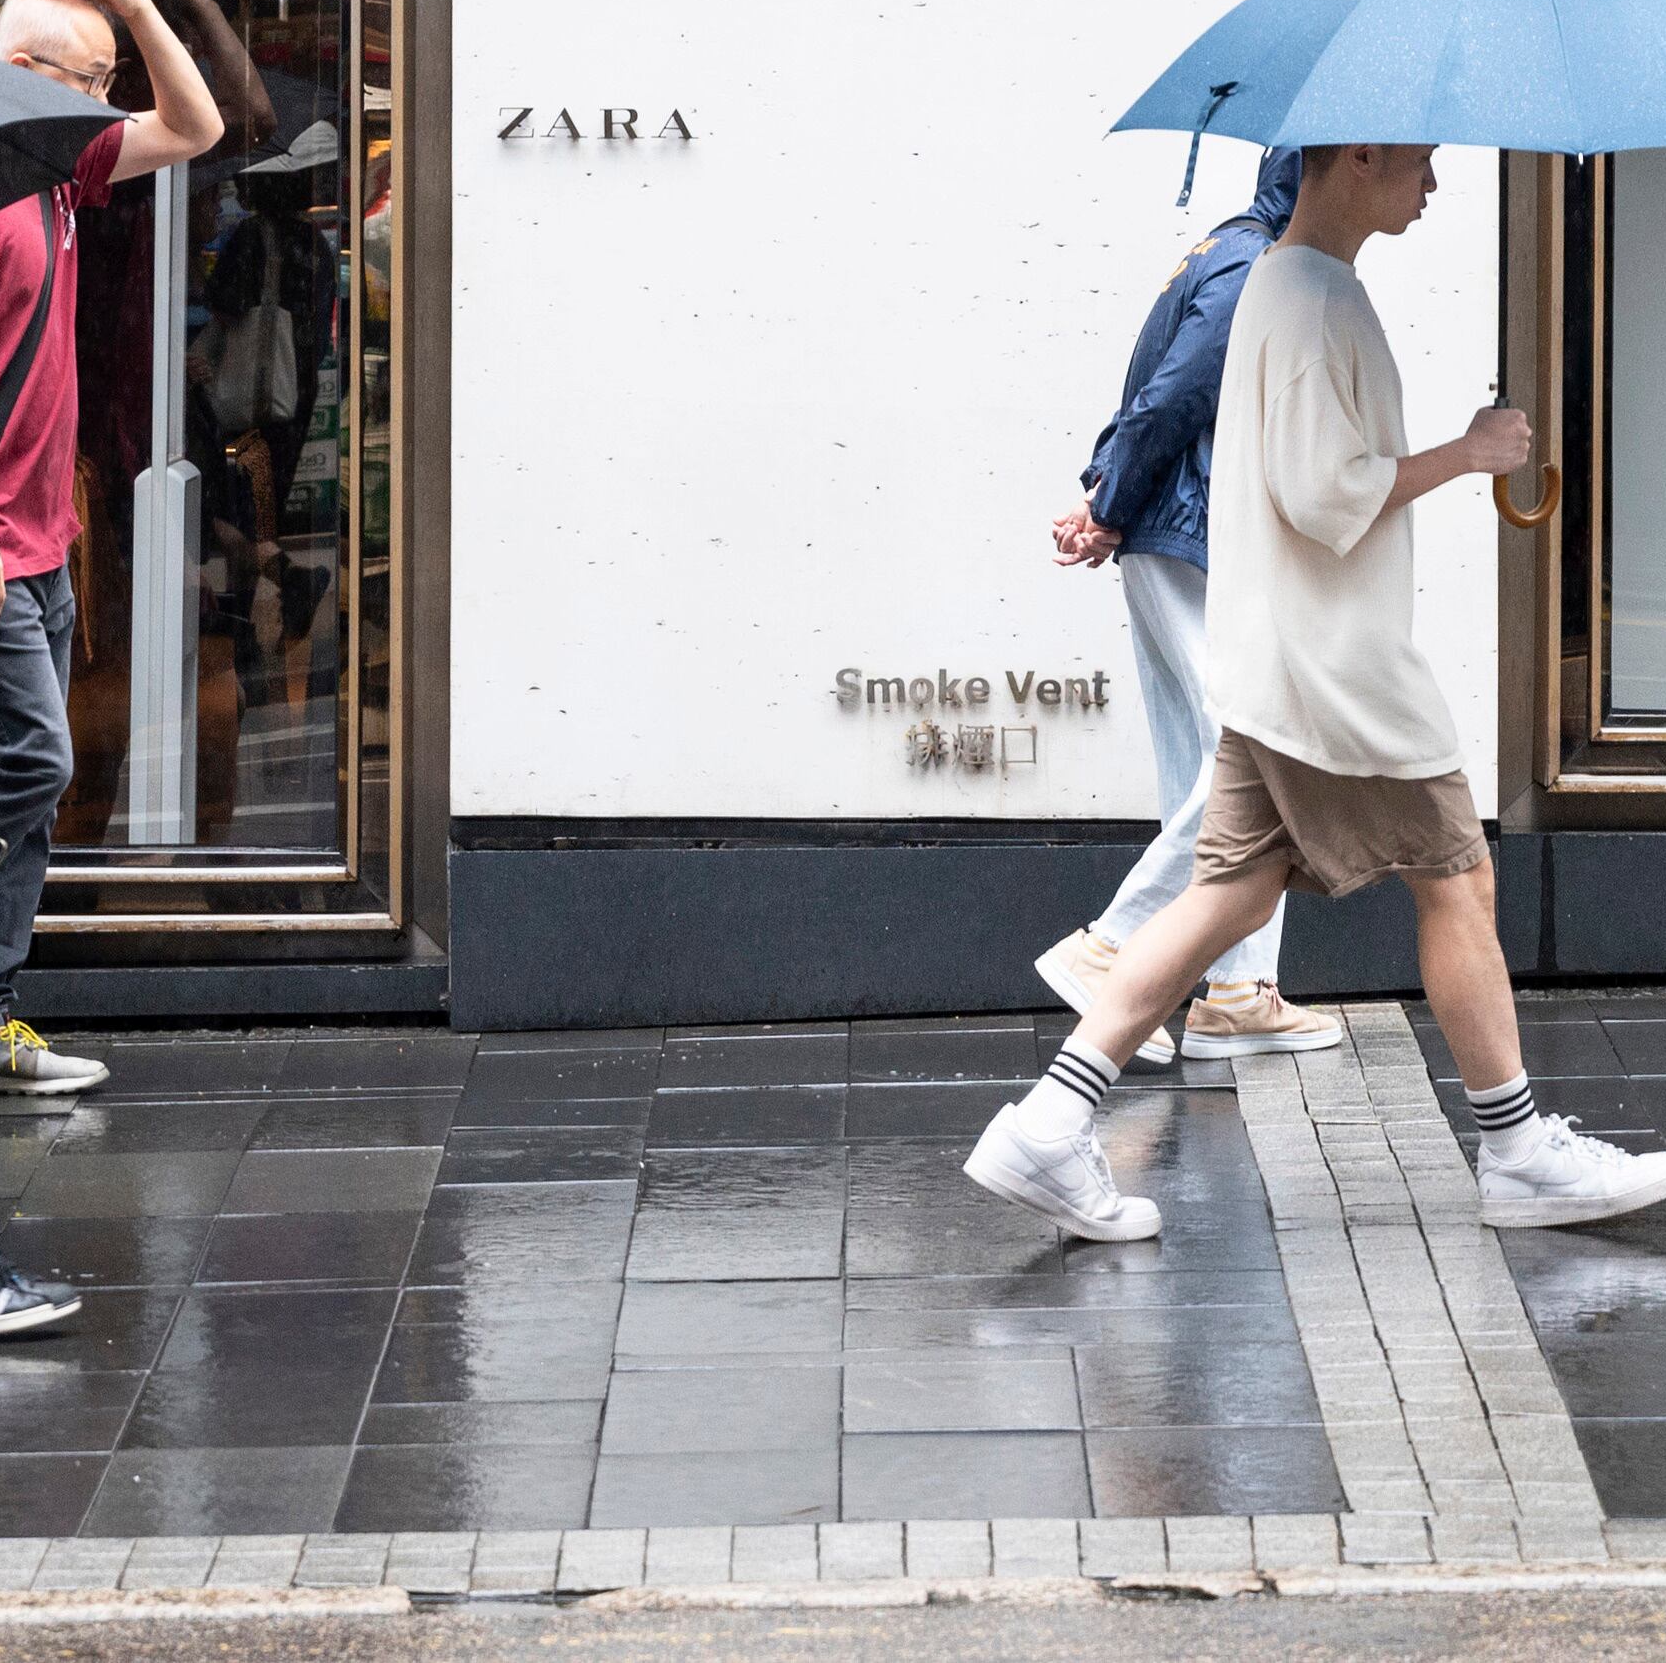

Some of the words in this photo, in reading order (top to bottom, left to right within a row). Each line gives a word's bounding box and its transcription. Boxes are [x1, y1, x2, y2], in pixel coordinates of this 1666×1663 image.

[497, 107, 699, 139] ZARA
[835, 668, 991, 705] Smoke
[1005, 670, 1111, 706] Vent
